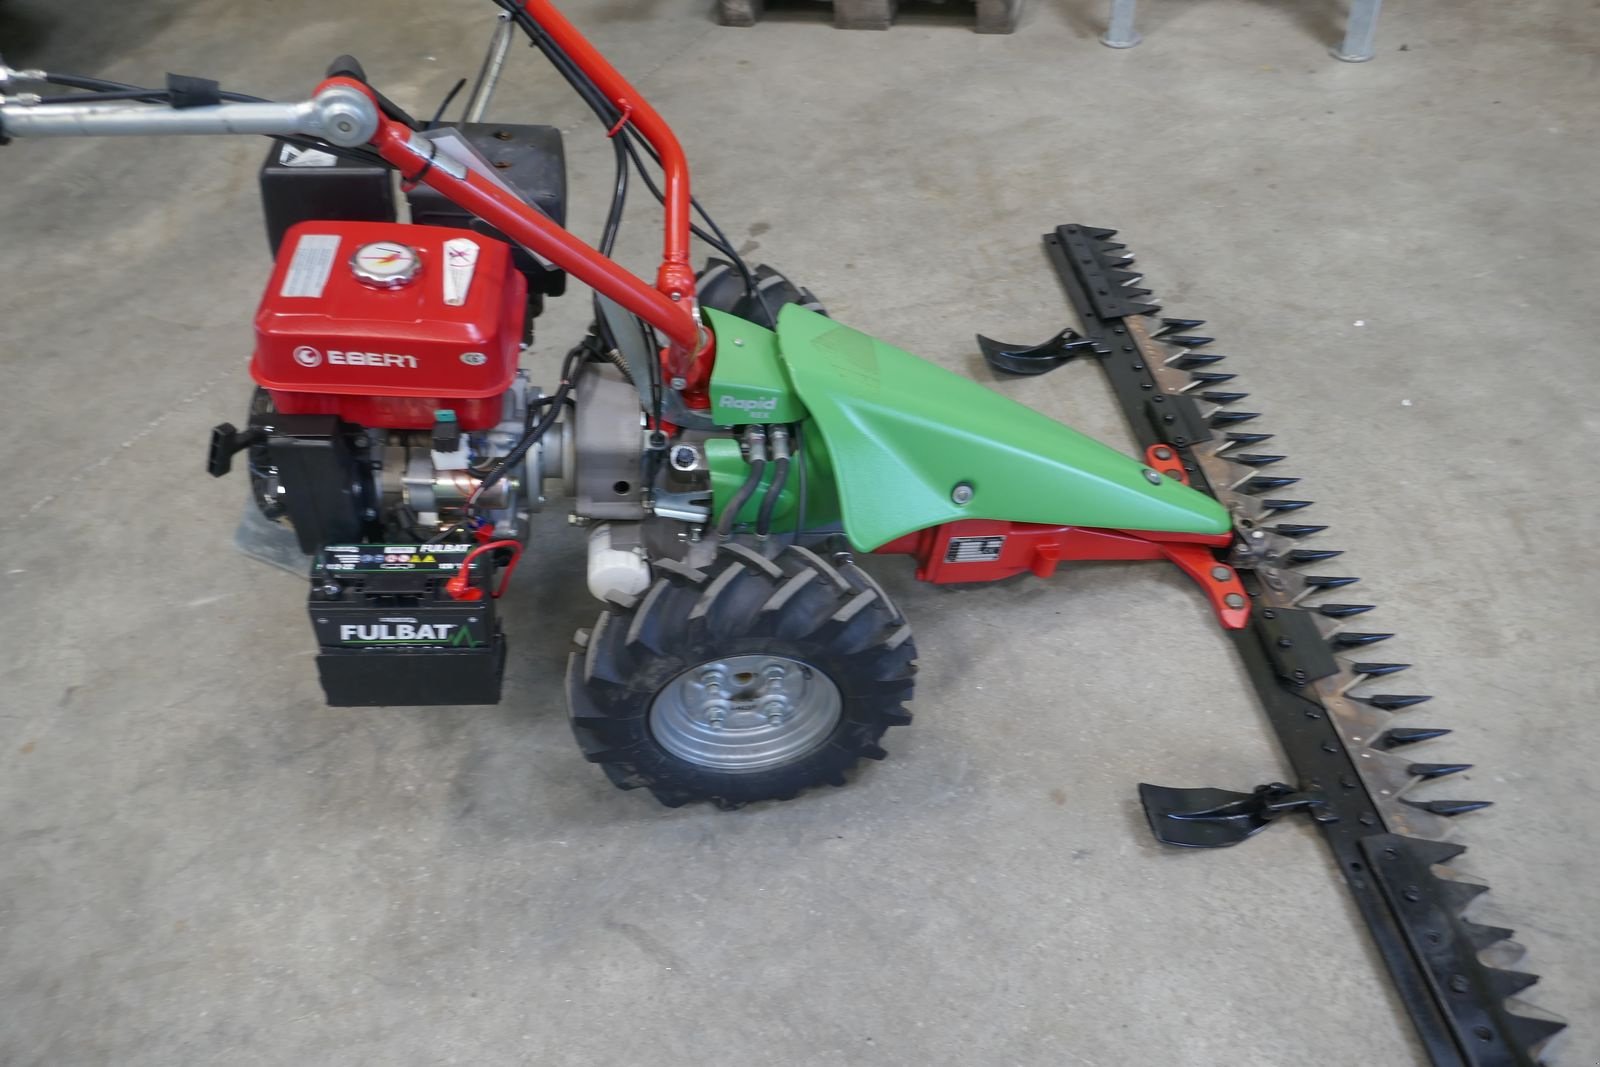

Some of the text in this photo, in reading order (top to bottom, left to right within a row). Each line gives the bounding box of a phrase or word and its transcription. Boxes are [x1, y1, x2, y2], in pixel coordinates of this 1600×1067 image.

[326, 350, 419, 368] EBERT
[719, 395, 777, 411] Rapid
[420, 544, 471, 553] FULBAT
[340, 624, 457, 640] FULBAT
